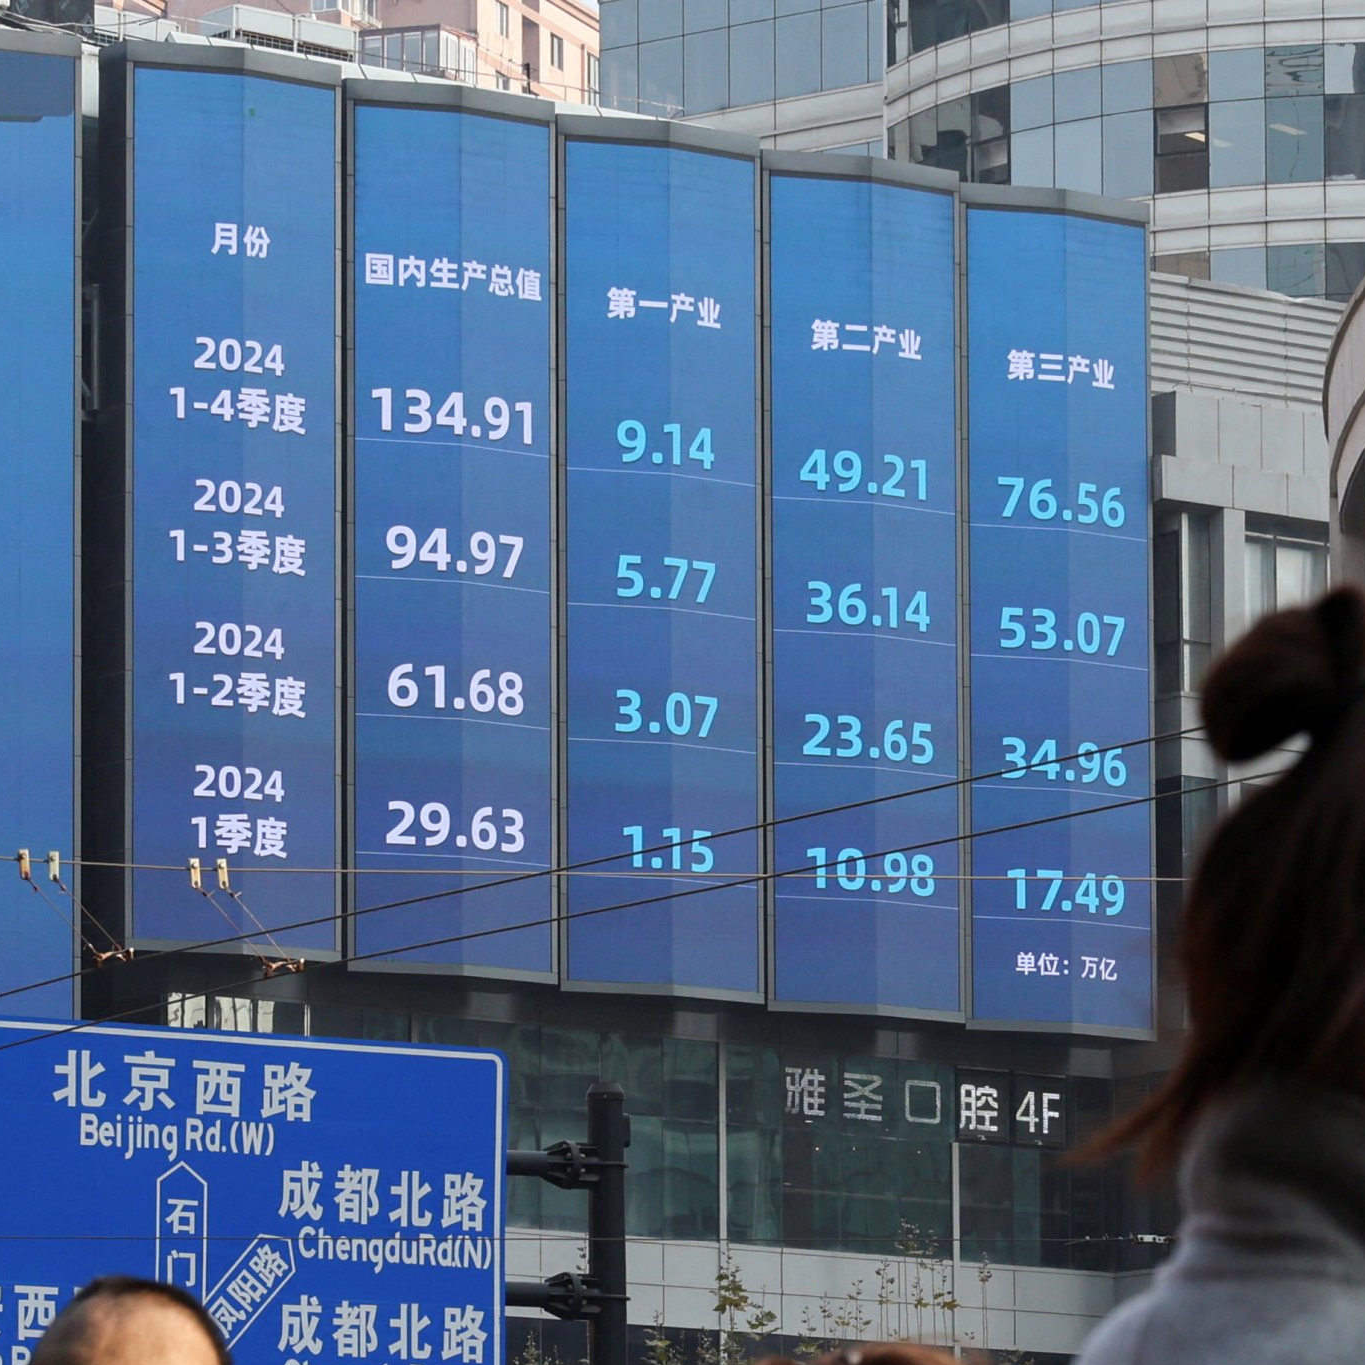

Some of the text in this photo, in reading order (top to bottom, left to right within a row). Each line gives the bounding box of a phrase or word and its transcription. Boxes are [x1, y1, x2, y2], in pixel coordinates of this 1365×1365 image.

[210, 223, 271, 258] 月份
[365, 253, 542, 301] 国内生产总值
[607, 287, 721, 329] 第一产业
[194, 337, 285, 376] 2024
[811, 319, 922, 360] 第二产业
[1007, 349, 1115, 390] 第三产业
[169, 387, 306, 434] 1-4季度
[371, 388, 533, 444] 134.91
[616, 420, 715, 469] 9.14
[194, 479, 285, 518] 2024
[799, 449, 927, 500] 49.21
[997, 477, 1125, 527] 76.56
[169, 530, 306, 577] 1-3季度
[386, 526, 524, 578] 94.97
[617, 555, 716, 603] 5.77
[806, 581, 931, 632] 36.14
[194, 622, 285, 660] 2024
[1000, 607, 1126, 656] 53.07
[169, 673, 306, 719] 1-2季度
[387, 664, 524, 716] 61.68
[615, 690, 718, 738] 3.07
[802, 714, 934, 764] 23.65
[1001, 737, 1127, 787] 34.96
[194, 765, 285, 802] 2024
[190, 814, 288, 859] 1季度
[385, 801, 525, 853] 29.63
[623, 826, 714, 873] 1.15
[806, 848, 935, 897] 10.98
[1007, 869, 1125, 916] 17.49
[1015, 952, 1118, 981] 单位：万亿
[53, 1049, 317, 1122] 北京西路
[1016, 1091, 1060, 1134] 4F
[81, 1114, 275, 1161] Beijing Rd.(W)
[279, 1161, 487, 1232] 成都北路
[207, 1244, 289, 1339] 凤阳路
[278, 1295, 488, 1364] 成都北路
